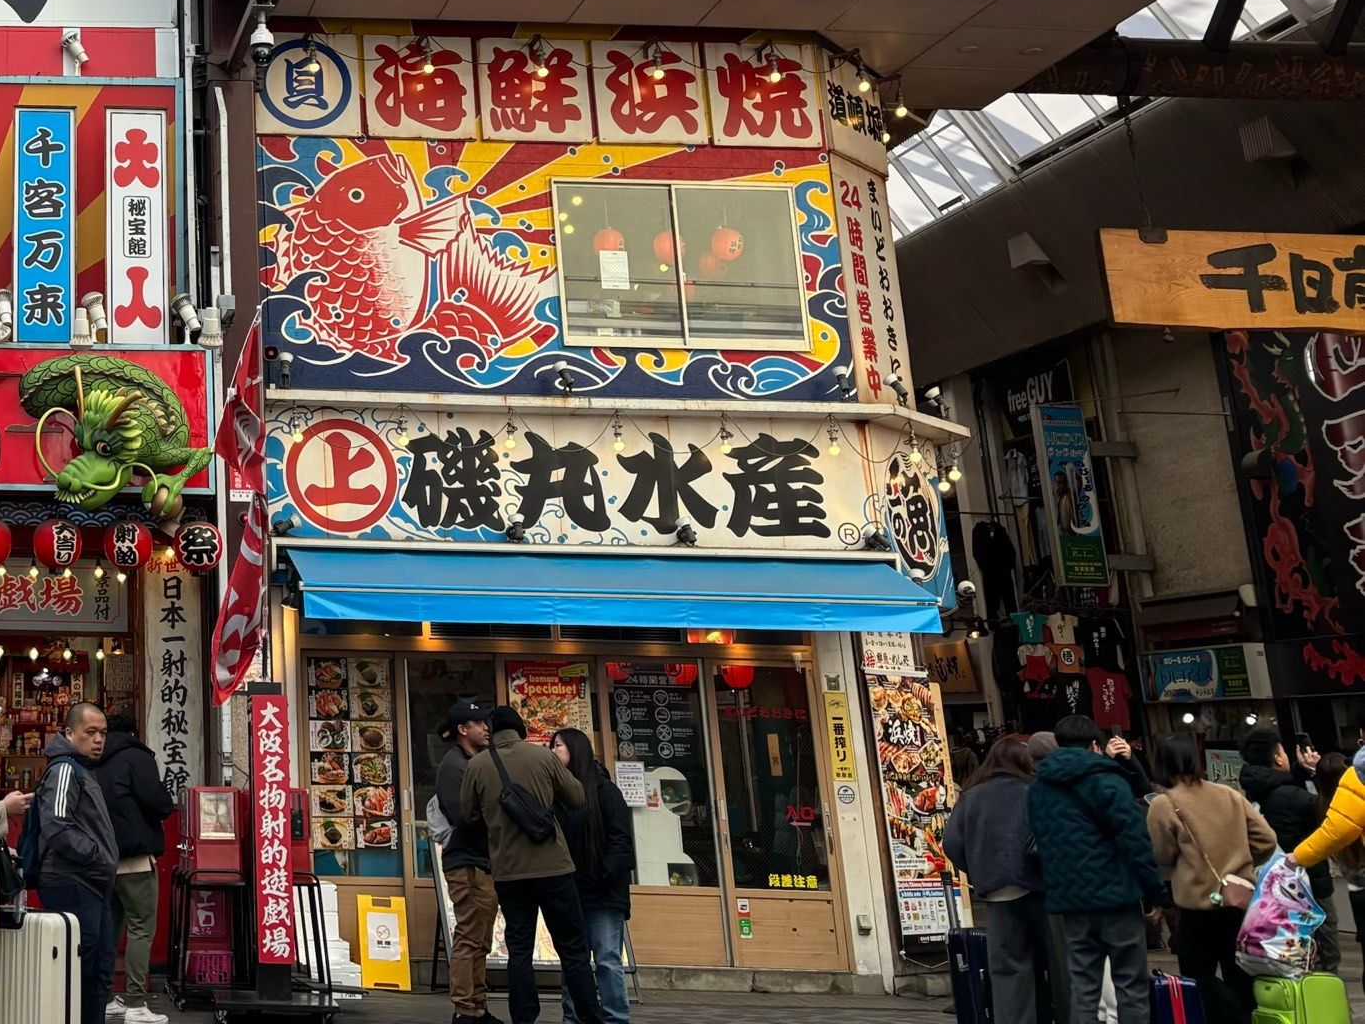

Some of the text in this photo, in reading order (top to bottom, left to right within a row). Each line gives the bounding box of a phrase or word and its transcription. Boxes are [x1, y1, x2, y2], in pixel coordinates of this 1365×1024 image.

[371, 41, 815, 139] 海鮮浜焼
[827, 79, 884, 142] 道頓堀
[23, 127, 65, 327] 千客万来
[127, 198, 148, 256] 秘宝館
[839, 180, 882, 400] 24時間営業中
[402, 426, 832, 540] 磯丸水産
[54, 521, 76, 564] 大当り
[113, 522, 139, 566] 射的
[180, 525, 218, 565] 祭
[94, 573, 111, 621] 景品付
[159, 575, 190, 798] 日本一射的秘宝館
[831, 716, 848, 762] 一番搾り
[888, 719, 916, 745] 浜焼
[257, 701, 291, 959] 大阪名物射的遊戯場
[768, 874, 819, 889] 段差注意
